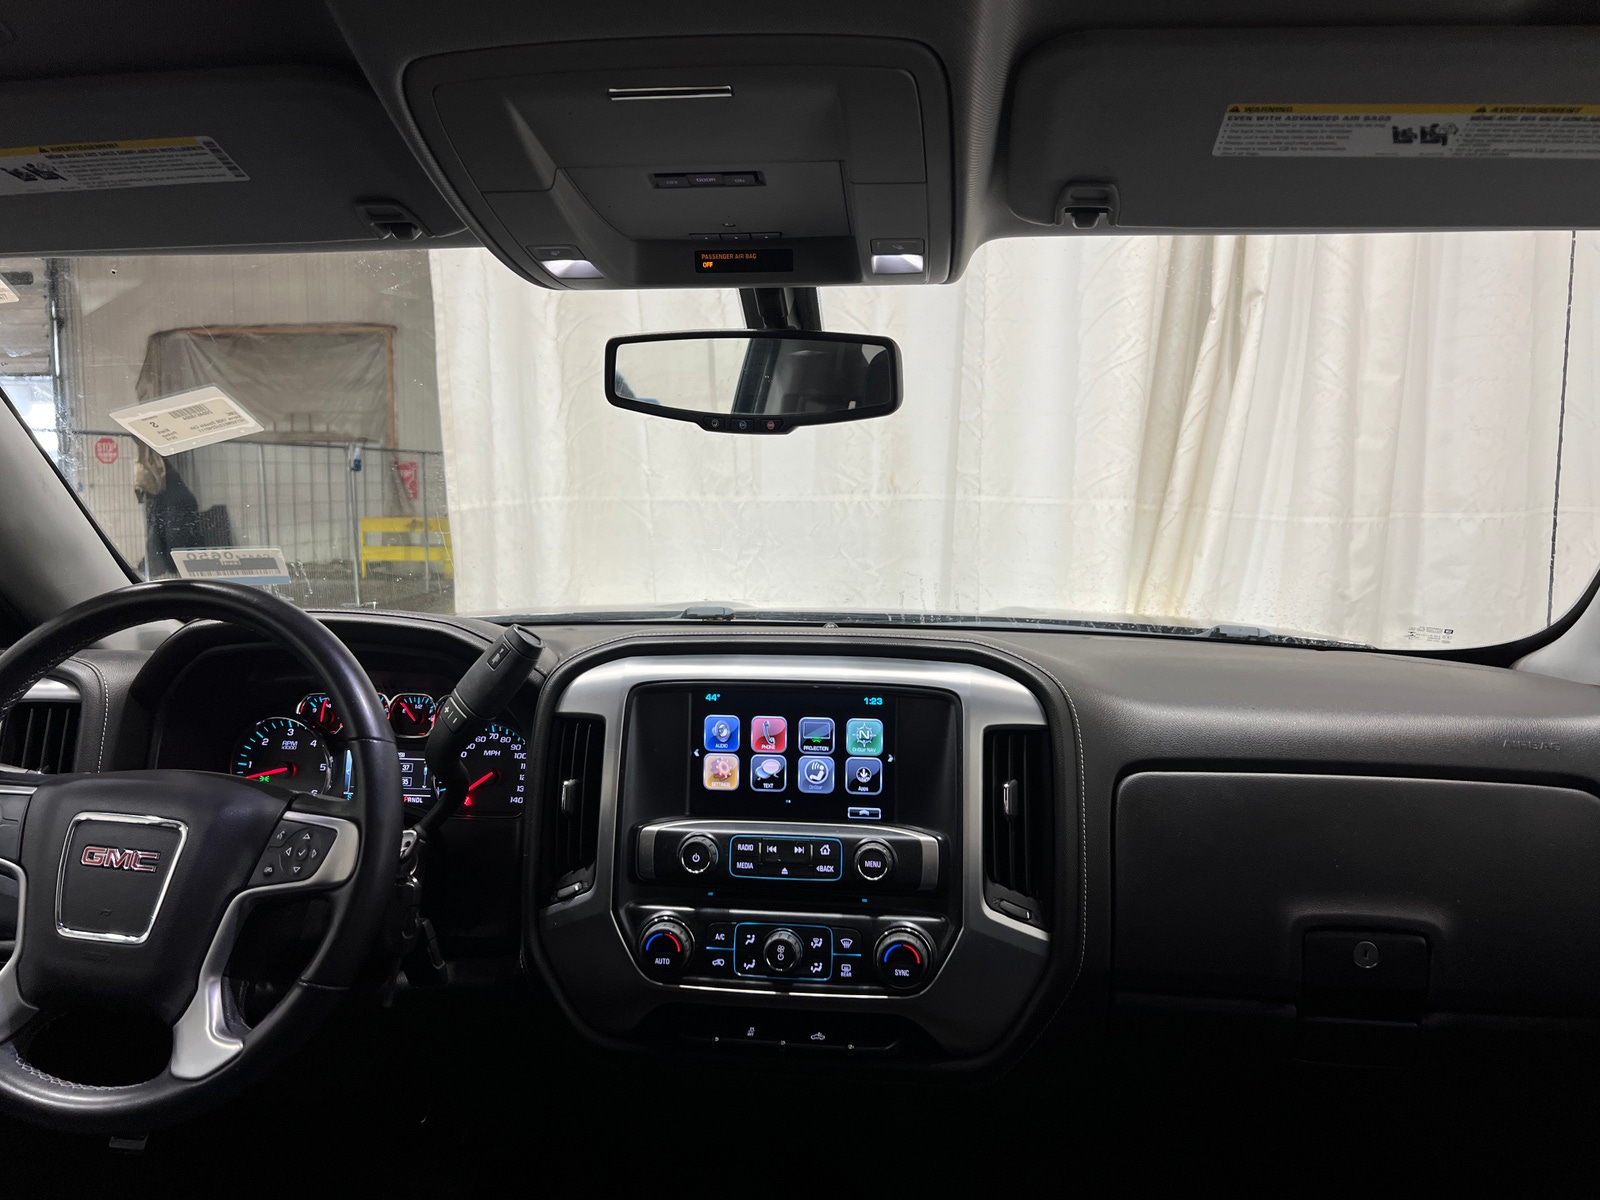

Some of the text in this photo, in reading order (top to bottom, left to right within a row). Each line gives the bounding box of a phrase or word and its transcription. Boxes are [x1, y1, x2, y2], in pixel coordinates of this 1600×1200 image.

[97, 442, 117, 453] STOP
[863, 697, 883, 706] 1:23
[286, 728, 294, 736] 3
[489, 732, 499, 740] 70
[261, 738, 270, 746] 2
[310, 739, 317, 747] 4
[1502, 739, 1561, 751] AIRBAG
[248, 761, 253, 769] 1
[319, 763, 327, 771] 5
[510, 796, 524, 804] 140
[81, 845, 161, 873] GMC
[736, 862, 754, 870] MEDIA
[864, 860, 882, 868] MENU
[818, 865, 834, 873] BACK
[714, 933, 726, 941] A/C
[654, 957, 671, 965] AUTO
[894, 969, 910, 977] SYNC
